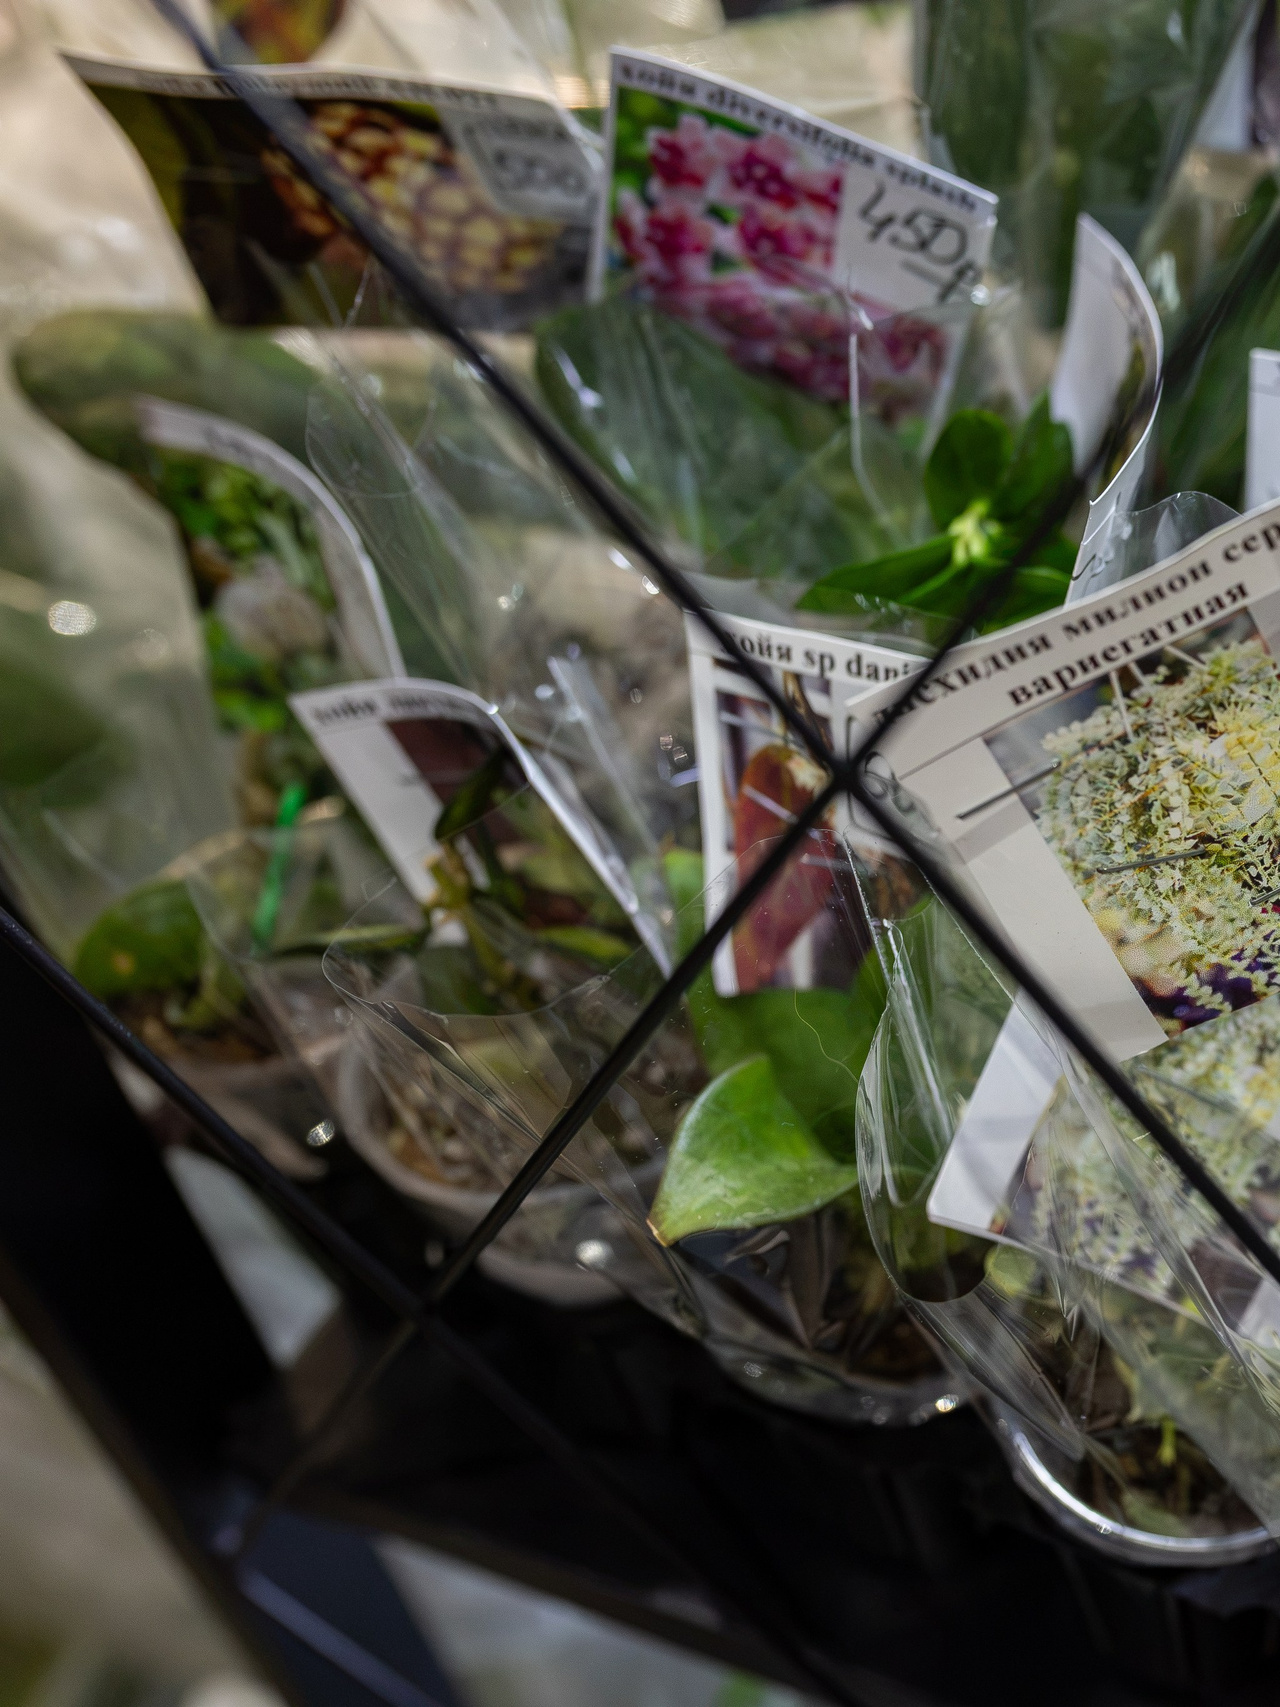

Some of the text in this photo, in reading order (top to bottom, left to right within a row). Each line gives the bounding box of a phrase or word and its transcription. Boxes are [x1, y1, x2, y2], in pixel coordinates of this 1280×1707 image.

[1060, 560, 1214, 642] милион
[804, 650, 836, 679] sp
[1006, 581, 1250, 708] вариегатная
